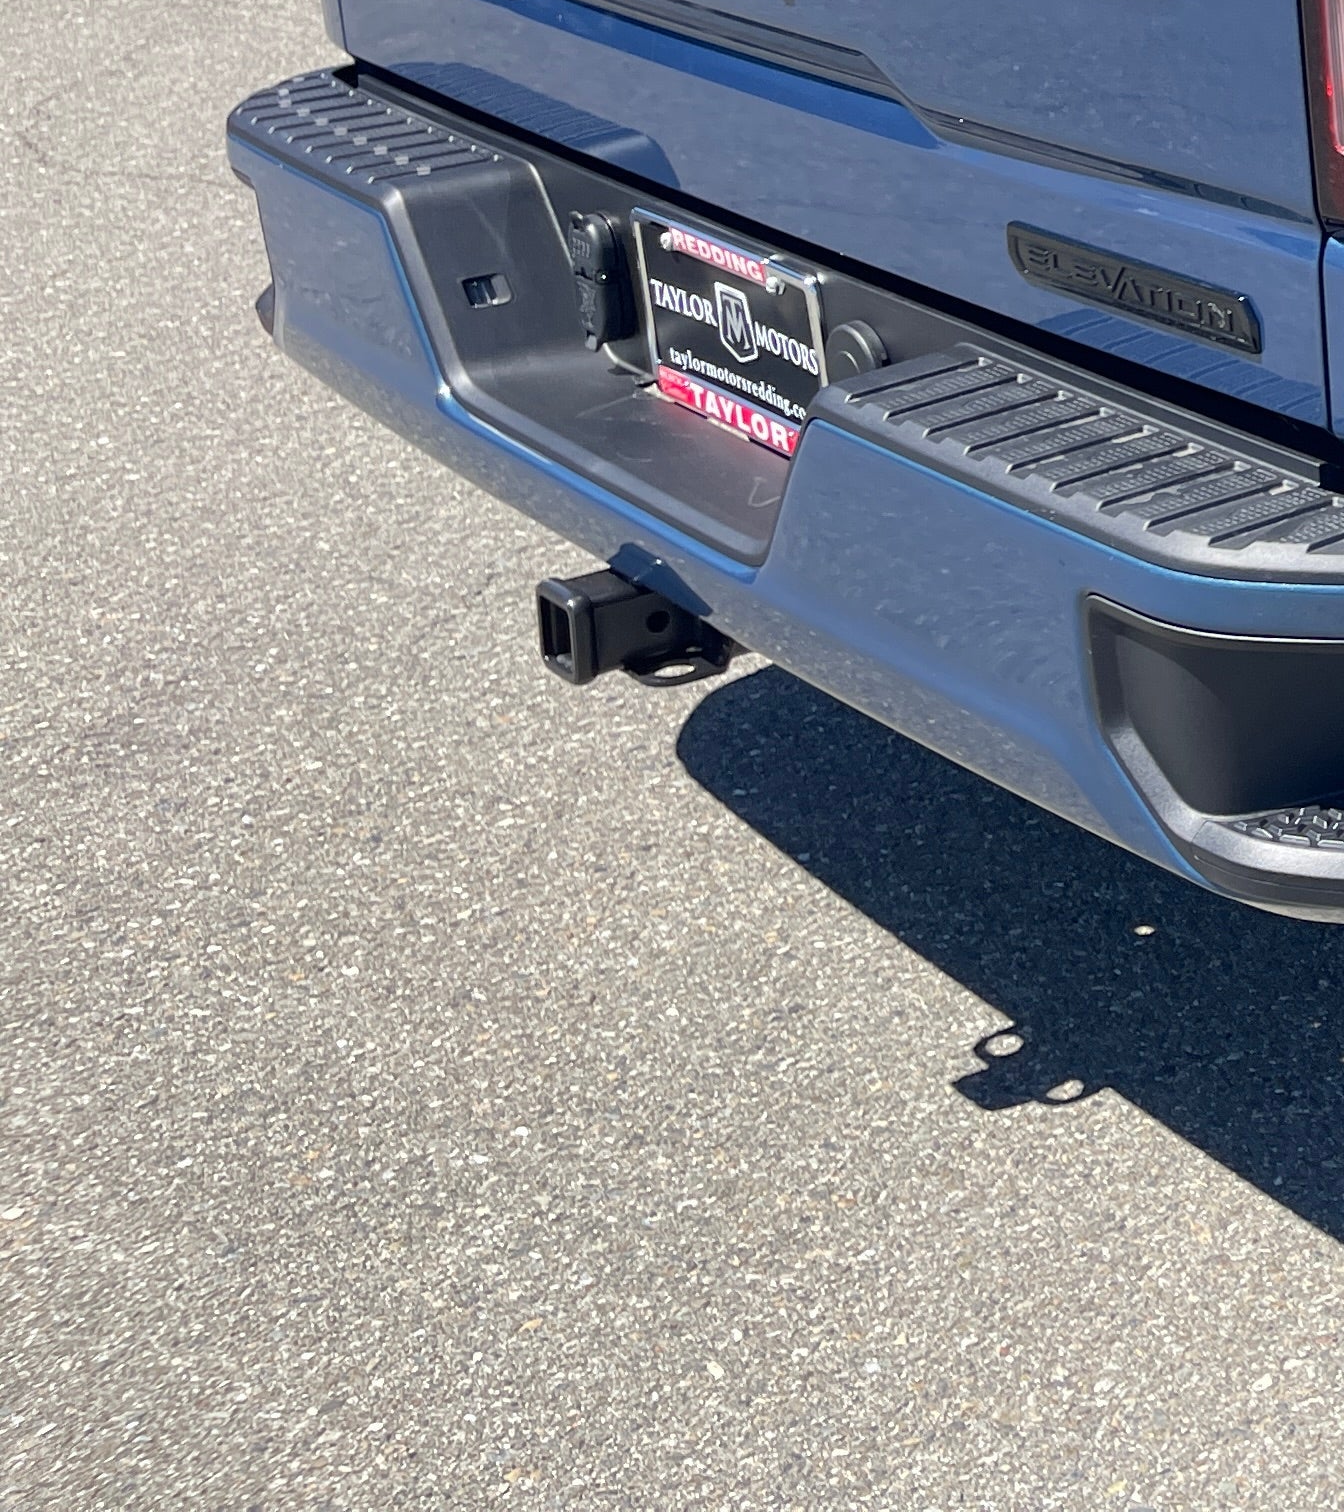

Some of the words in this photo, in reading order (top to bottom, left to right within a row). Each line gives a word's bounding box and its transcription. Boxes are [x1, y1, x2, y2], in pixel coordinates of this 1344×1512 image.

[670, 227, 764, 283] REDDING
[1028, 245, 1236, 333] ELEVATION
[650, 278, 719, 328] TAYLOR
[754, 320, 820, 376] MOTORS
[668, 346, 807, 421] taylormotorsredding.co
